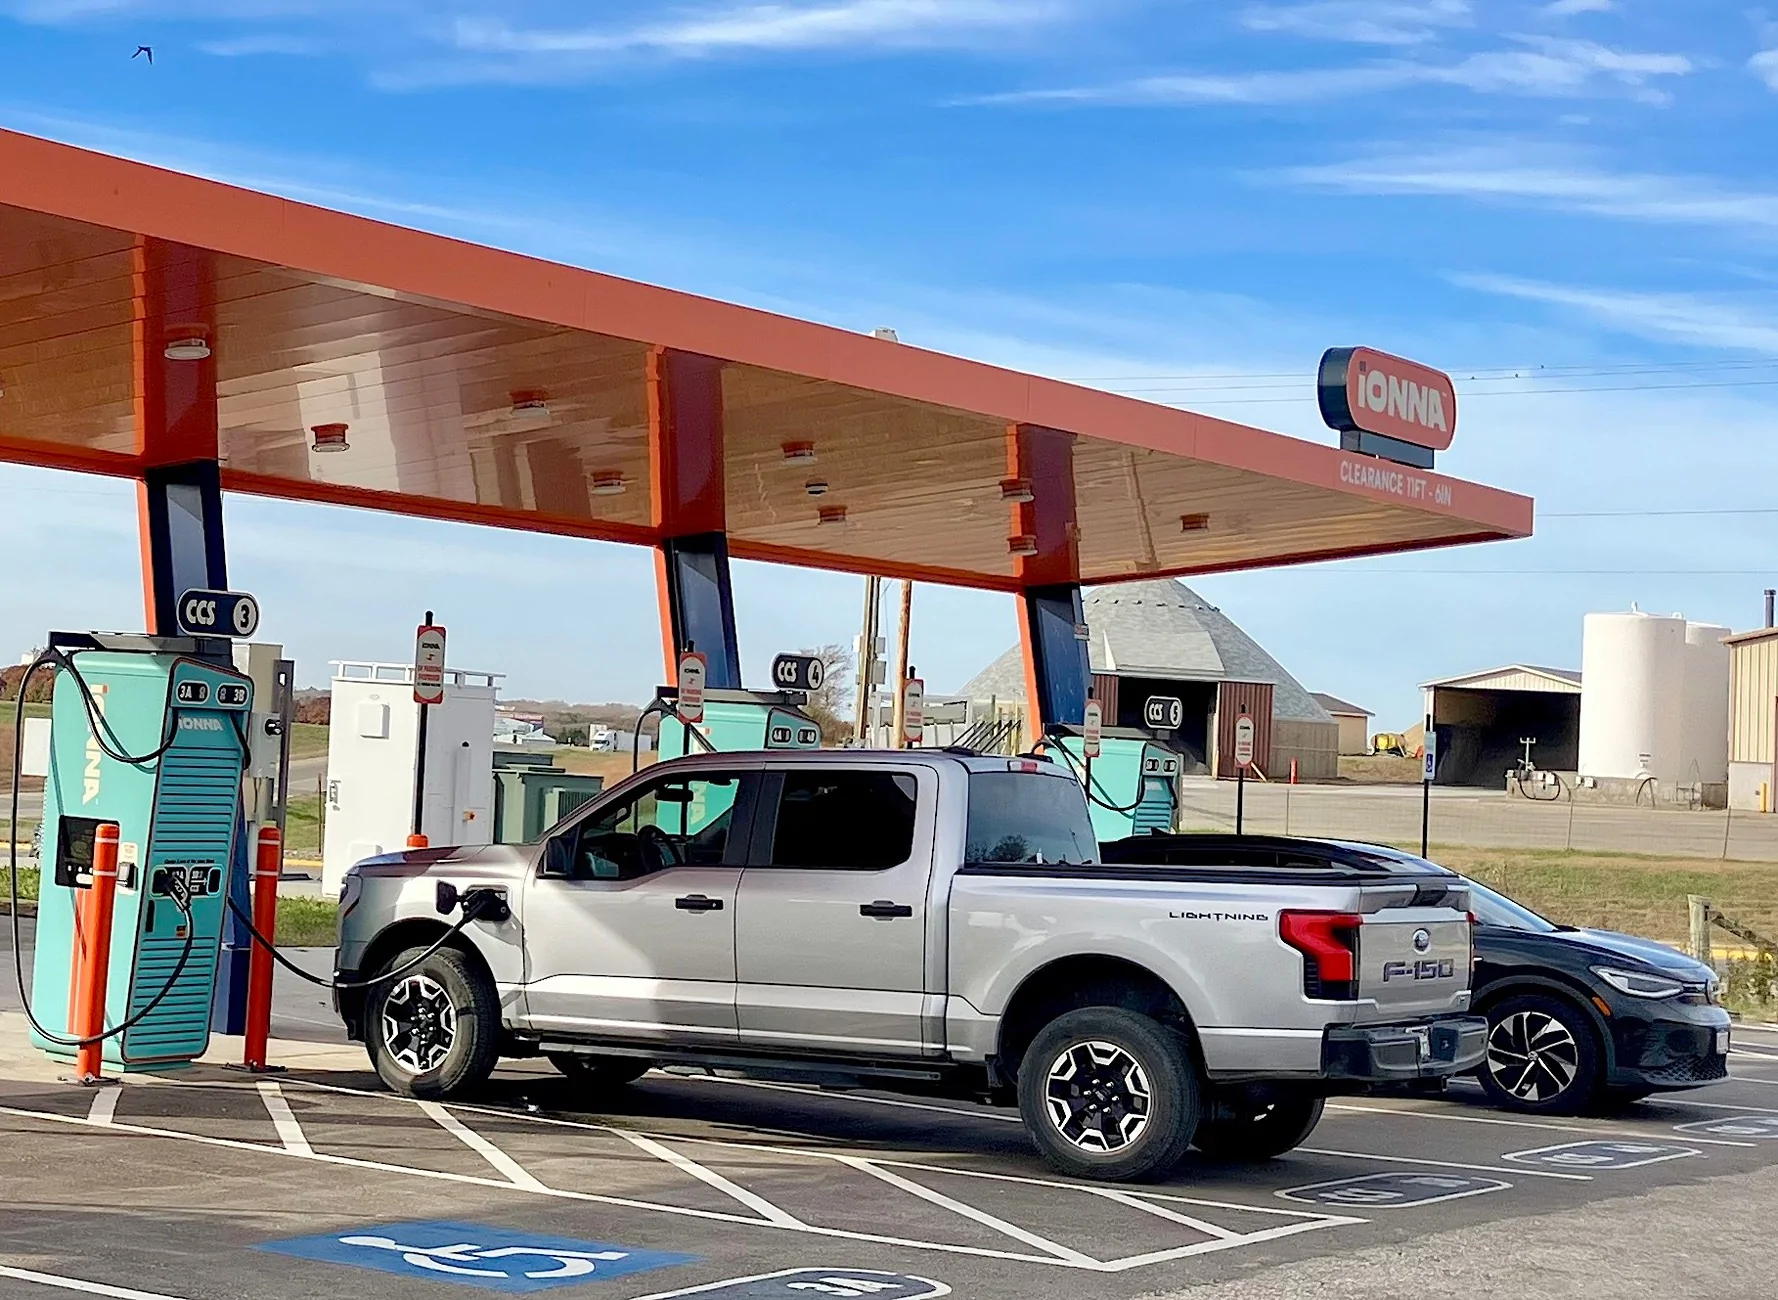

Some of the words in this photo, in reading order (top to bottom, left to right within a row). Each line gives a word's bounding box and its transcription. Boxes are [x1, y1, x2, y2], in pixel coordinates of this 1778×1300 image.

[1340, 460, 1403, 496] CLEARANCE
[1434, 484, 1452, 506] 6IN
[185, 598, 216, 627] CCS
[239, 603, 250, 629] 3
[777, 660, 798, 683] CCS
[812, 664, 819, 684] 4
[179, 685, 193, 699] 3A
[233, 688, 246, 702] 3B
[1148, 702, 1164, 721] CCS
[1173, 705, 1179, 722] 5
[1169, 911, 1269, 921] LIGHTNING
[1383, 958, 1454, 983] F-150
